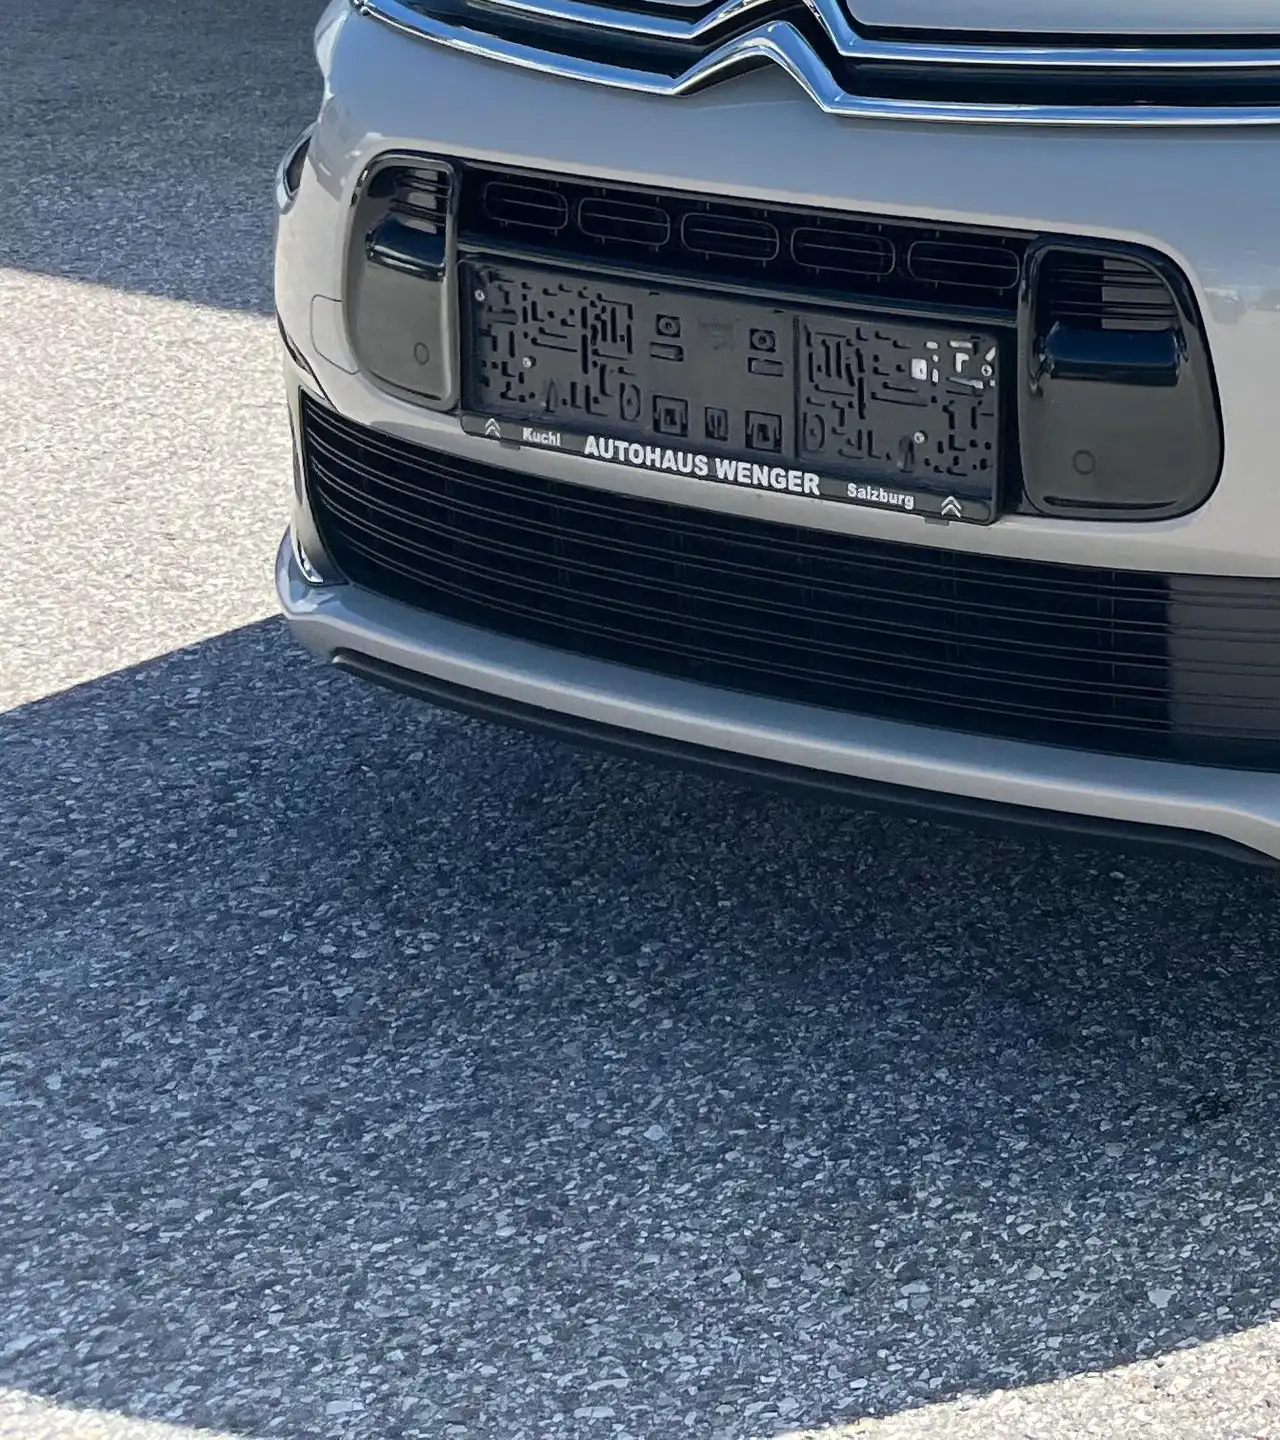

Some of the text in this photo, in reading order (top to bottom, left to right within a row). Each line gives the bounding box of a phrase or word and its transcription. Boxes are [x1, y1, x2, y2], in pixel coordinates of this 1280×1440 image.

[523, 426, 914, 510] Kuchl AUTOHAUS WENGER Salzburg
